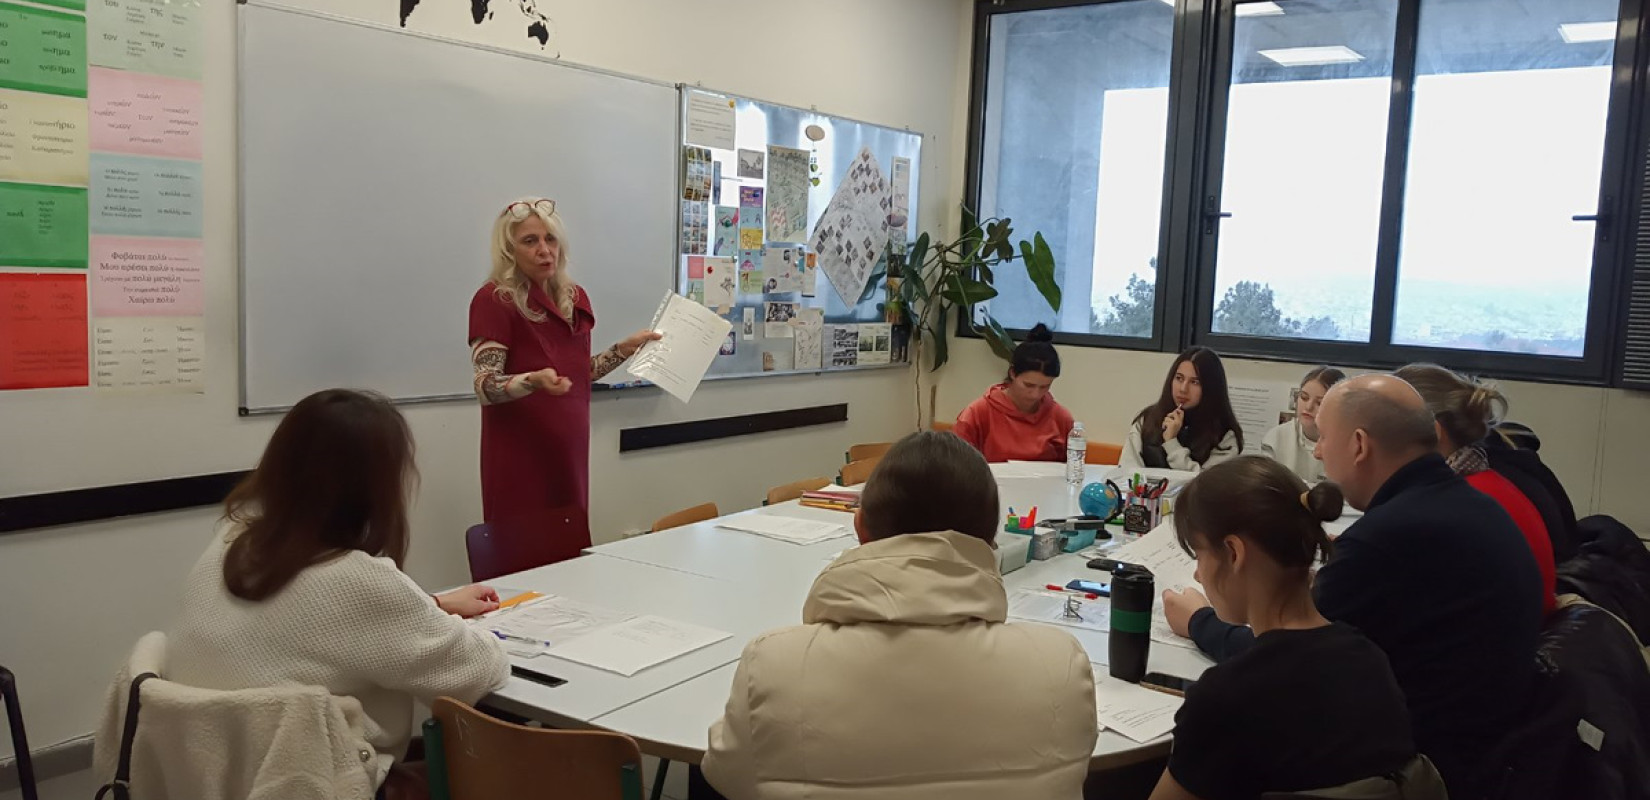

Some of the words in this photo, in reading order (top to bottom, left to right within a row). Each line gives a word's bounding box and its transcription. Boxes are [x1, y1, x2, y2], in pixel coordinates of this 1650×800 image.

[147, 253, 167, 261] πολύ
[100, 263, 119, 271] Μου
[150, 264, 168, 272] πολύ
[132, 274, 152, 282] πολύ
[161, 285, 180, 293] πολύ
[156, 295, 176, 304] πολύ
